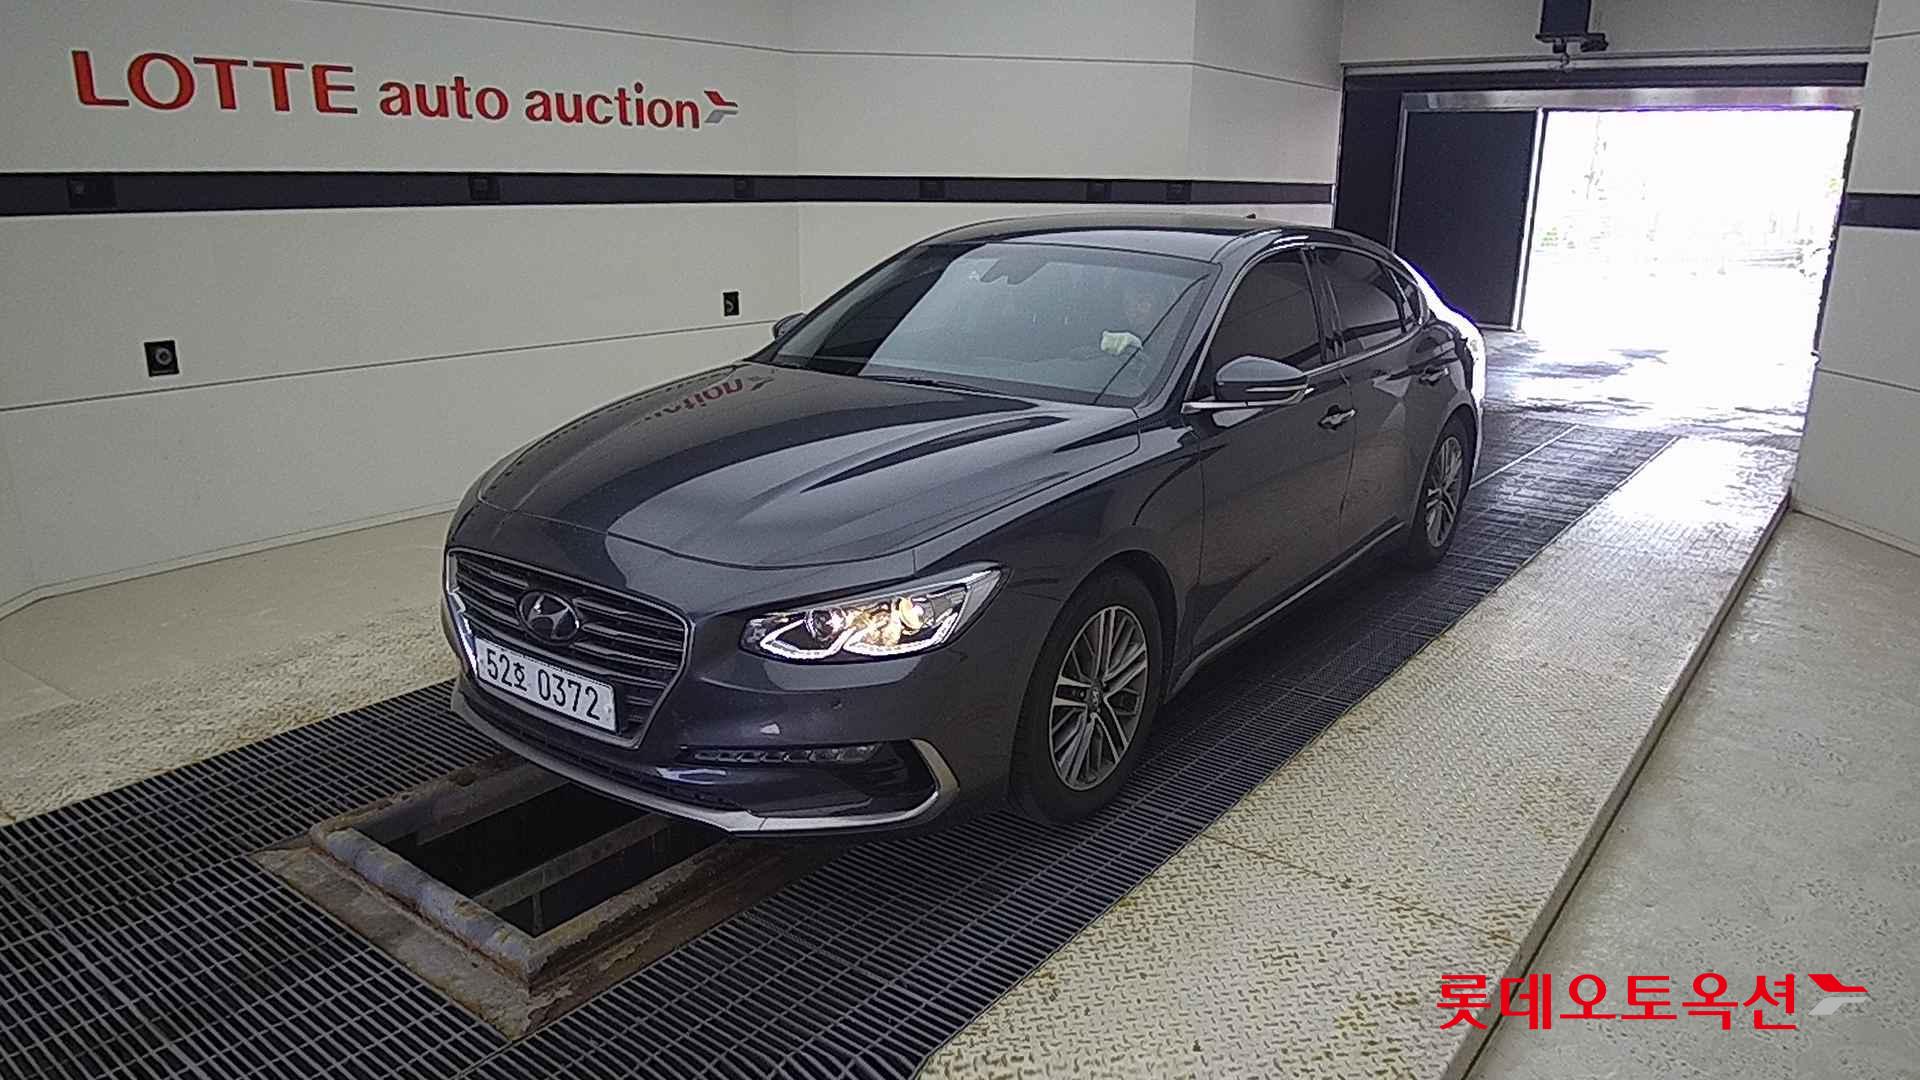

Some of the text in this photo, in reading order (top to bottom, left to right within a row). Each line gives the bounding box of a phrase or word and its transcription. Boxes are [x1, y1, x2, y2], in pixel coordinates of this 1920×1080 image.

[72, 50, 700, 129] LOTTE auto auction
[486, 647, 601, 721] 52호 0372
